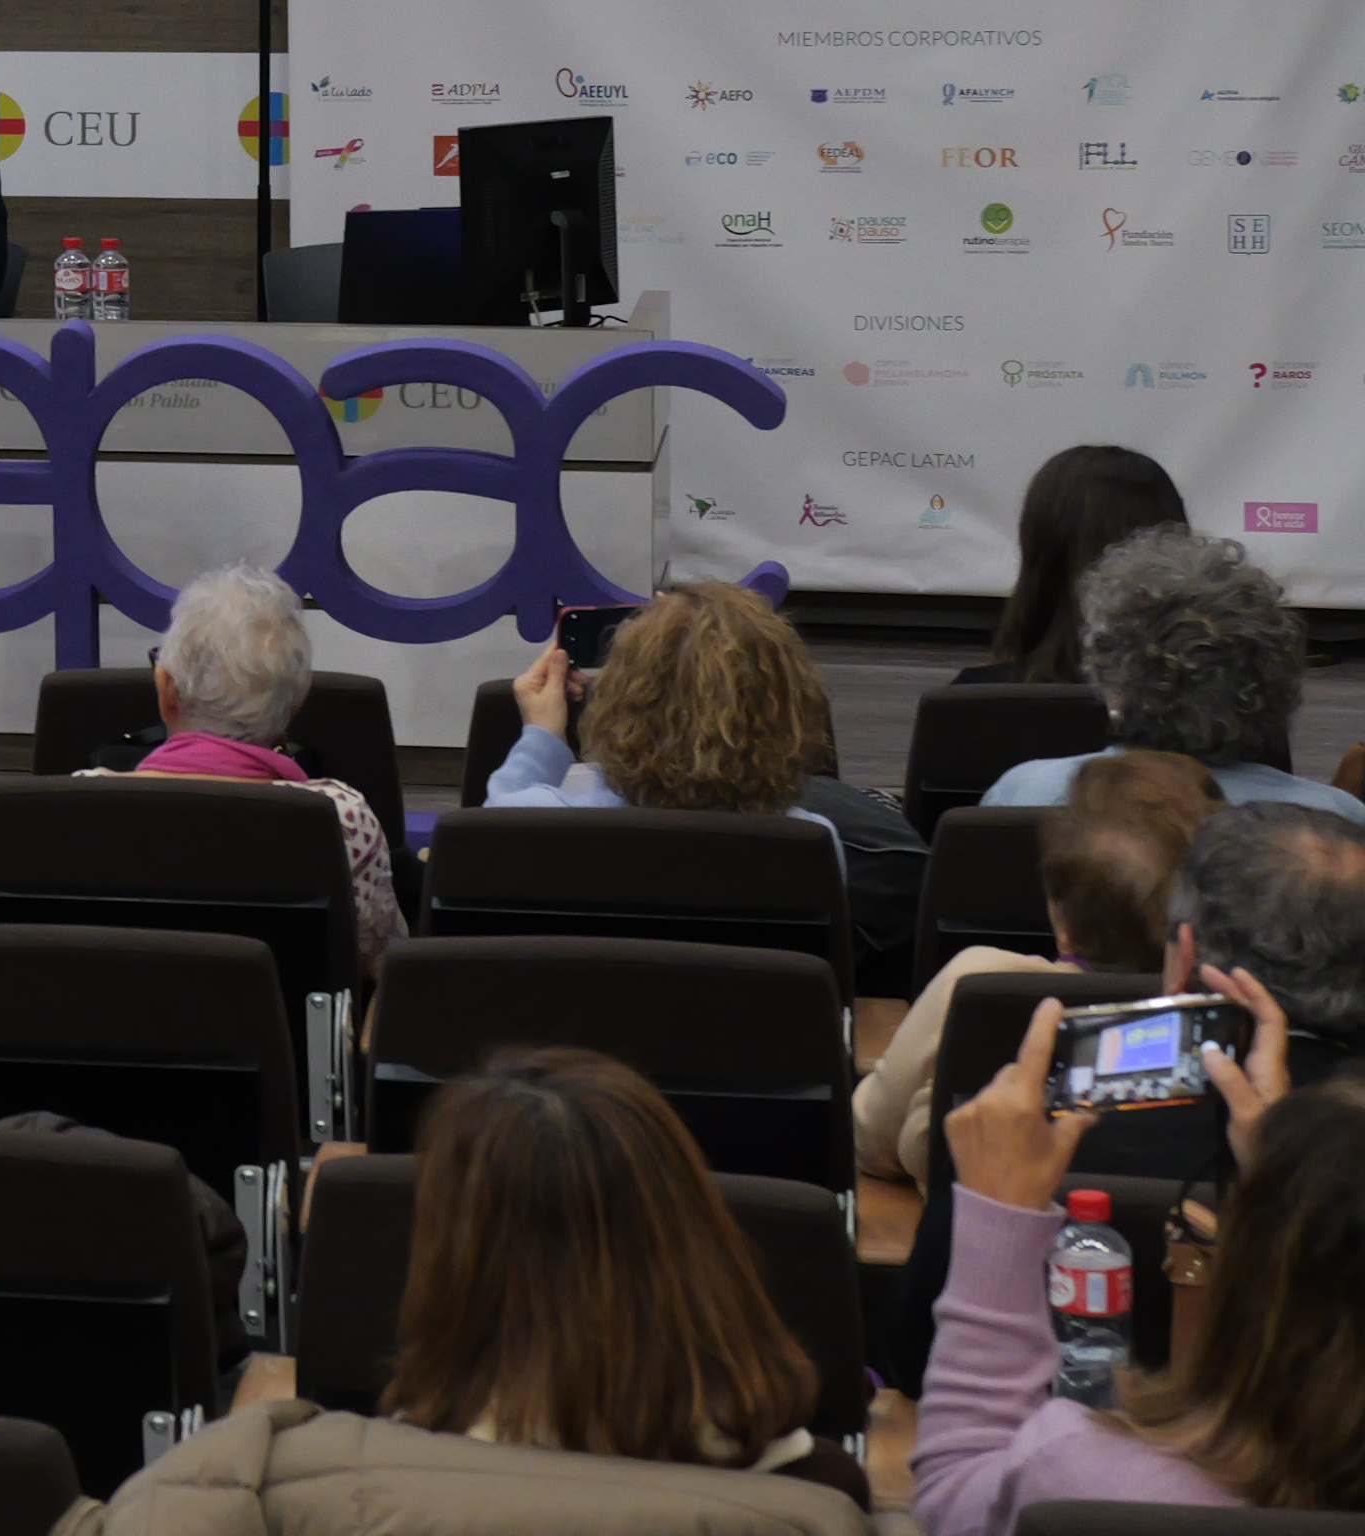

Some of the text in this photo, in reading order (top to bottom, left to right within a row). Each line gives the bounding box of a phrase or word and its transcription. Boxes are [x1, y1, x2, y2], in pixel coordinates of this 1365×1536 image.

[778, 30, 1043, 47] MIEMBROS CORPORATIVOS
[447, 83, 501, 97] ADPLA
[579, 84, 629, 99] AEEUYL
[719, 90, 753, 102] AEFO
[43, 110, 141, 147] CEU
[706, 152, 738, 166] eco
[941, 146, 1020, 168] FEOR
[854, 314, 965, 332] DIVISIONES
[150, 393, 201, 409] Pablo
[842, 450, 975, 469] GEPAC LATAM
